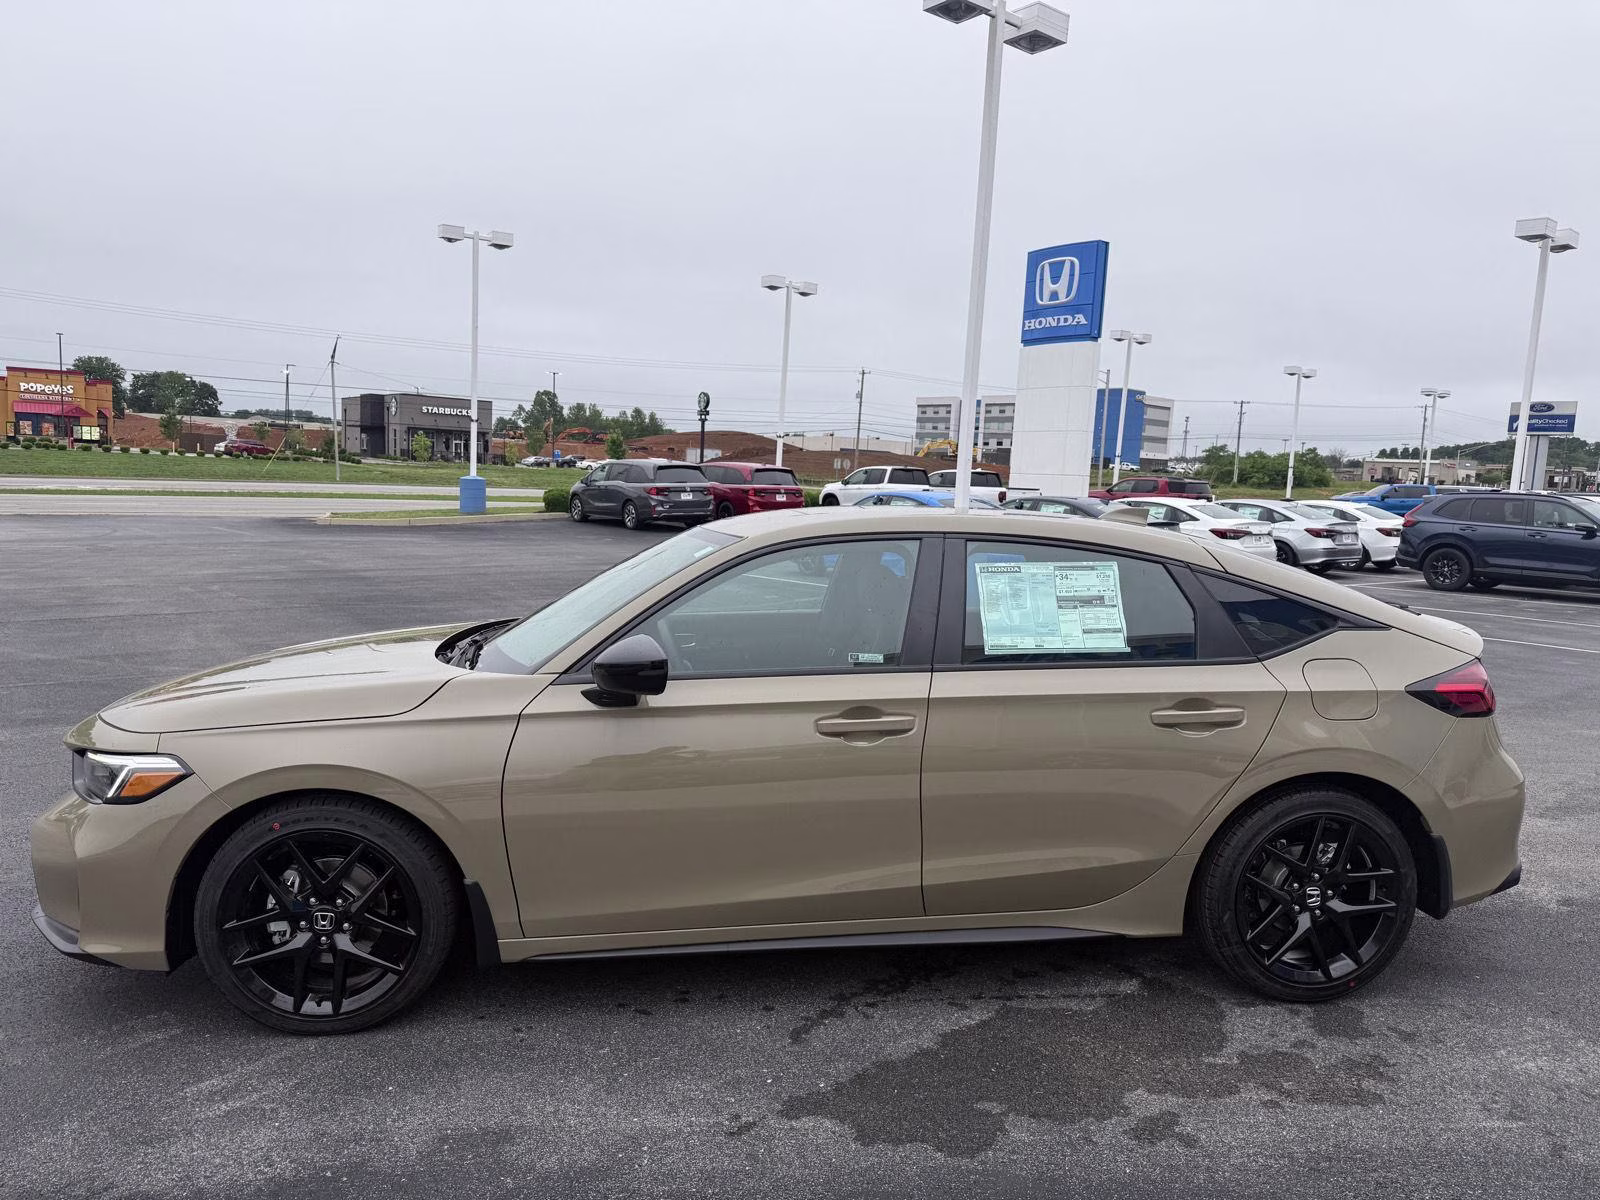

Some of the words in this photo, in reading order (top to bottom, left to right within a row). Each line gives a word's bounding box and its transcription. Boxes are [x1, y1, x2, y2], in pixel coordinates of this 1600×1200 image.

[1024, 314, 1088, 330] HONDA
[422, 406, 472, 416] STARBUCKS
[1058, 573, 1069, 581] 34
